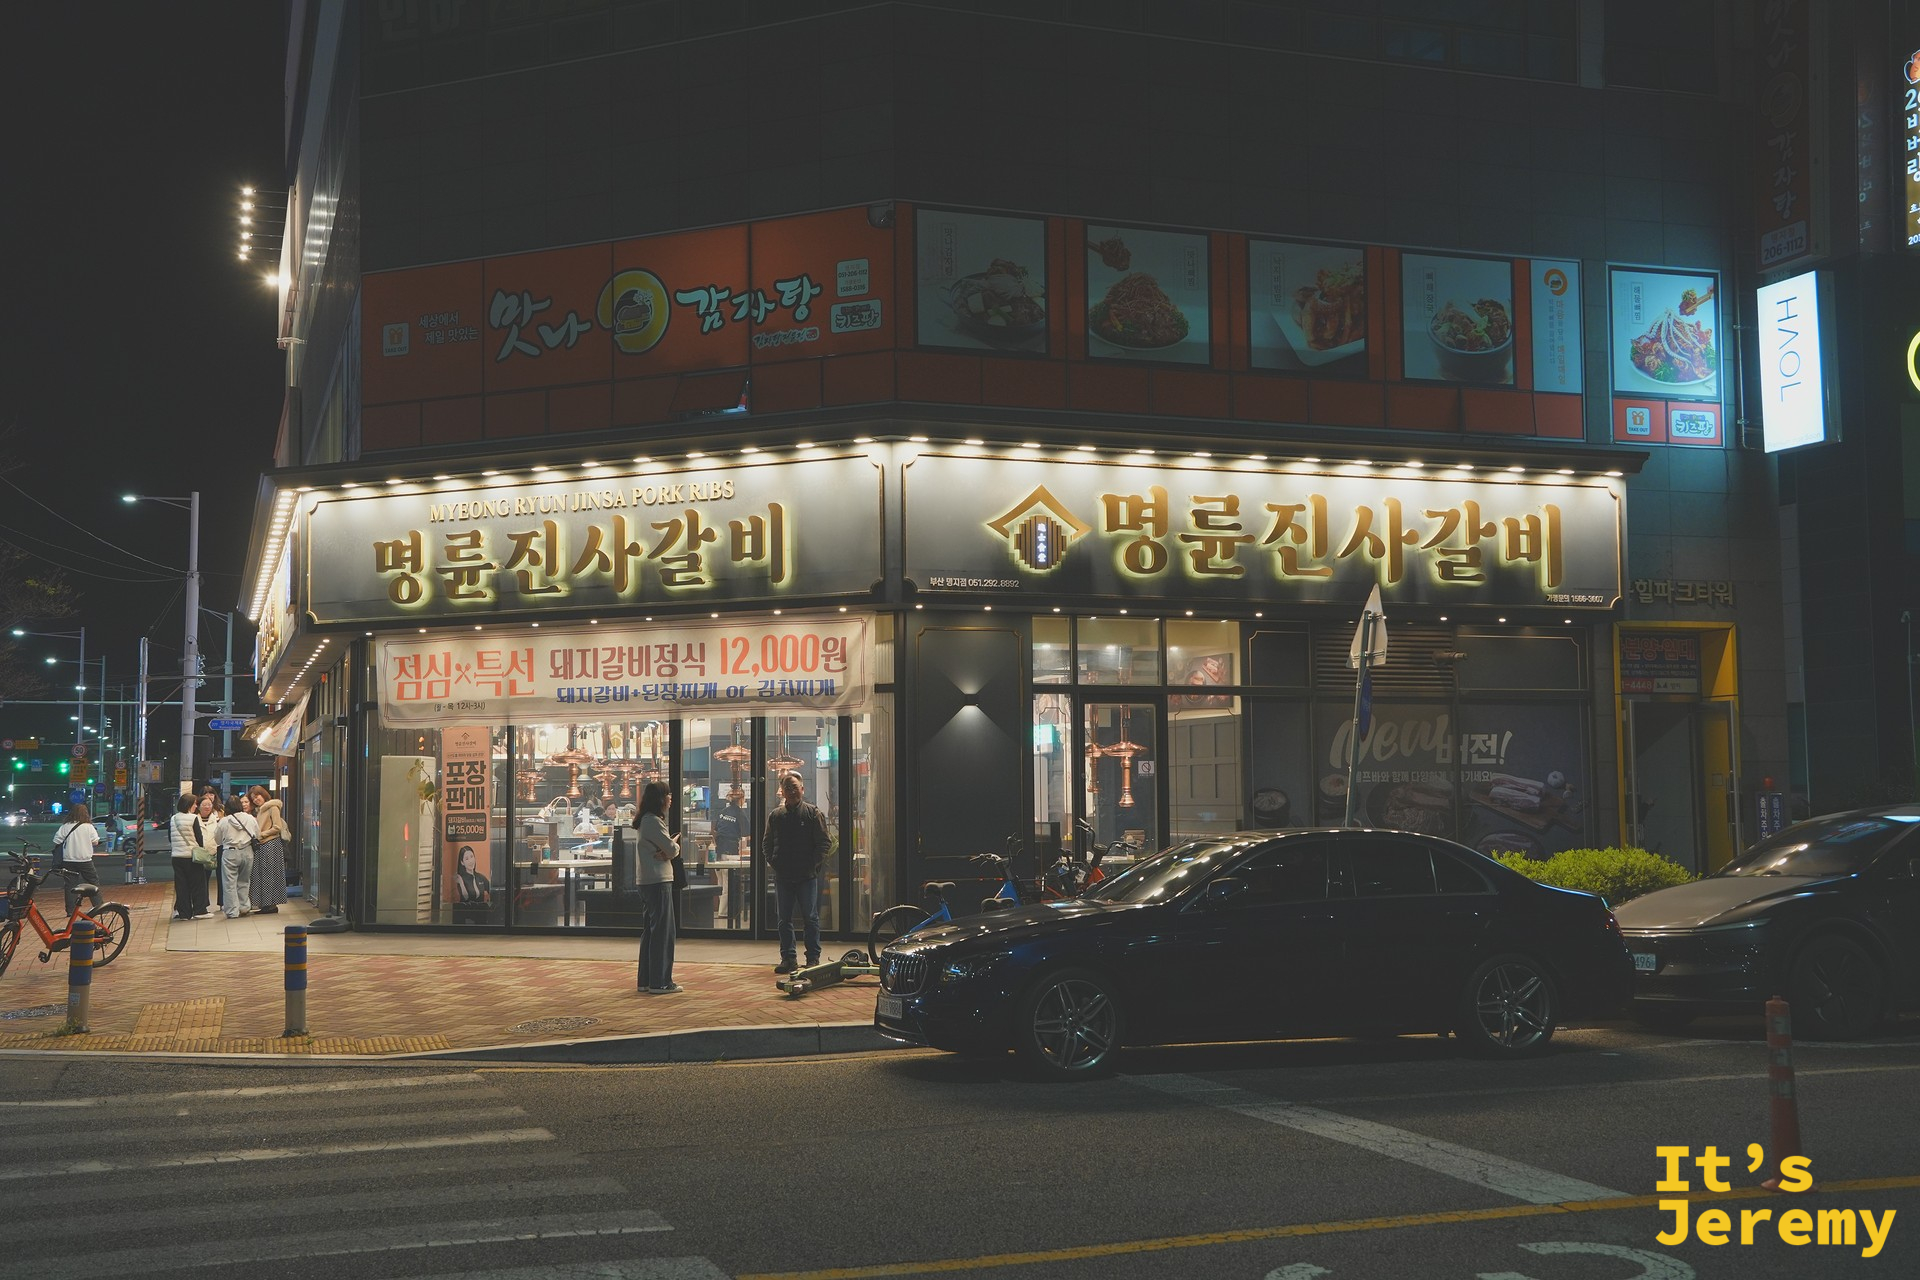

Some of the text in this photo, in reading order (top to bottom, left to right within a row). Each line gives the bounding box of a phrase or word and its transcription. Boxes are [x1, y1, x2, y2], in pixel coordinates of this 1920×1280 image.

[1764, 237, 1804, 262] 206-1112
[676, 274, 821, 335] 감자탕
[418, 311, 460, 328] 세상에서
[489, 289, 592, 362] 맛나
[448, 327, 481, 343] 맛있는
[429, 478, 736, 522] MYEONG RYUN JINSA PORK RIBS
[1100, 484, 1563, 588] 명륜진사갈비
[373, 502, 787, 604] 명륜진사갈비
[930, 577, 945, 588] 부산
[946, 577, 967, 588] 명지점
[1630, 579, 1734, 605] 힐파크타워
[393, 634, 848, 701] 점심 특선 돼지갈비정식 12,000원
[726, 684, 749, 699] or
[757, 678, 835, 699] 김치찌개
[446, 760, 487, 785] 포장
[445, 787, 485, 811] 판매
[456, 825, 485, 834] 25,000원
